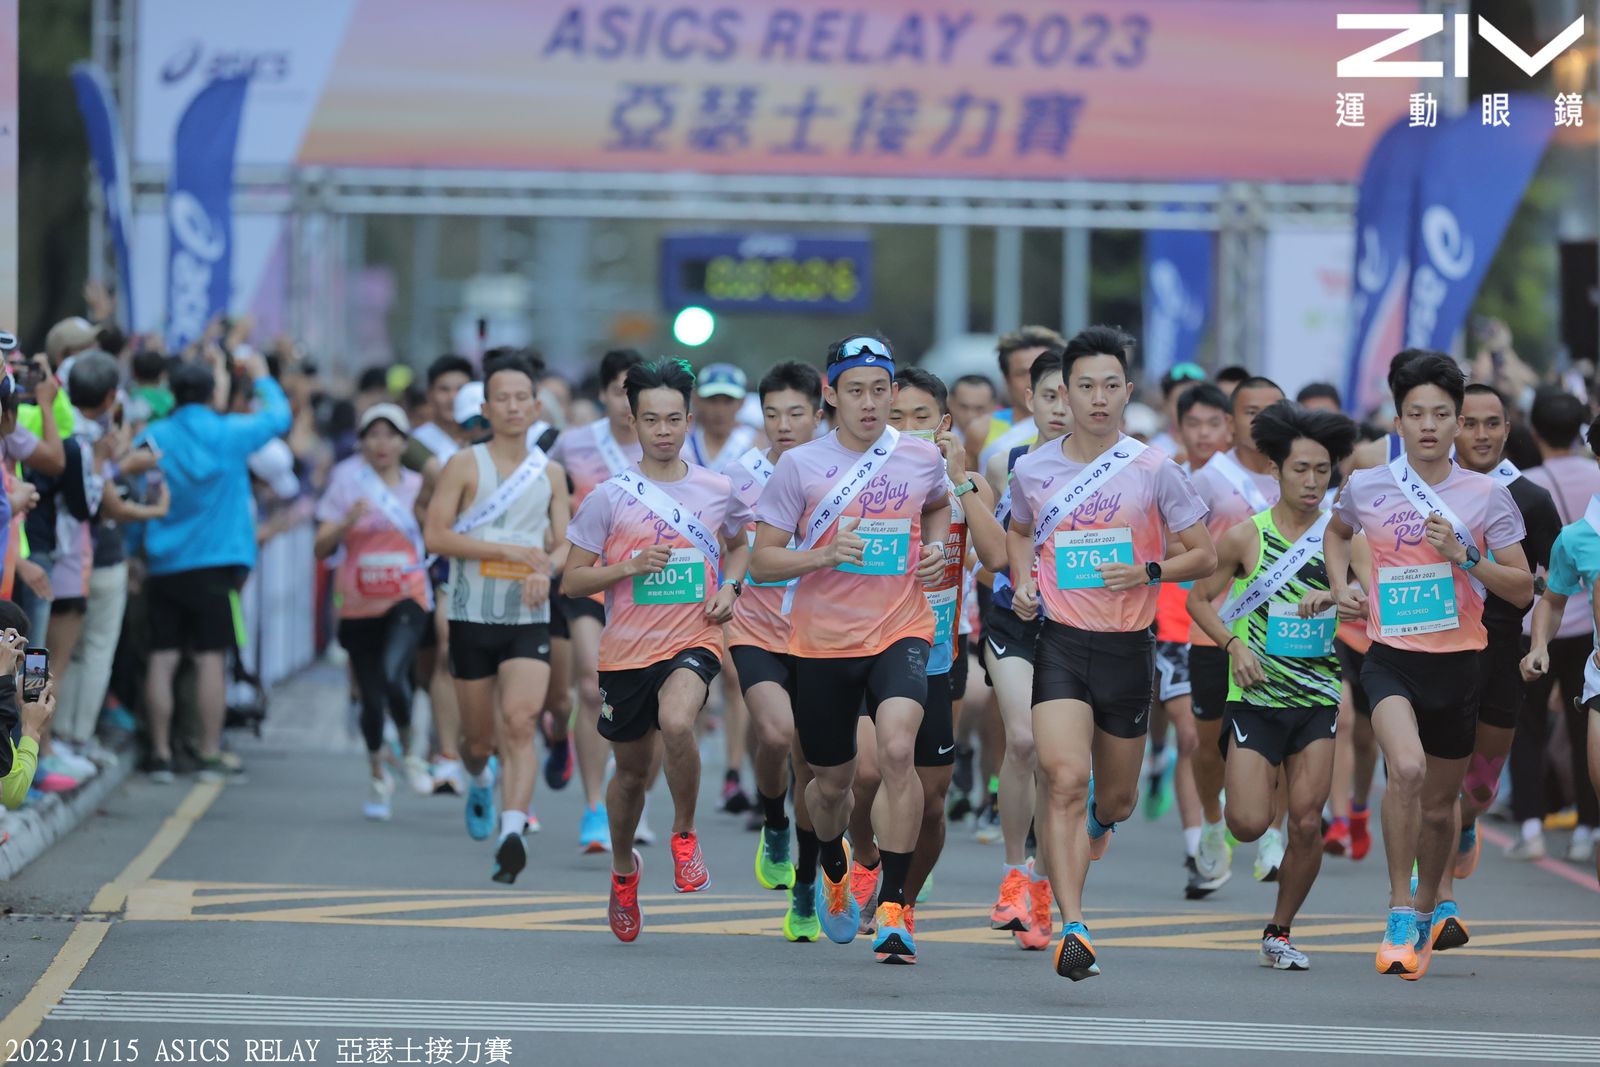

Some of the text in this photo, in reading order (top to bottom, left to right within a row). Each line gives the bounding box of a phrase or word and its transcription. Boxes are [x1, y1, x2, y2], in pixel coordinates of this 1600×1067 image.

[542, 5, 1153, 69] ASICS RELAY 2023
[601, 81, 1090, 158] 亞瑟士接力賽
[833, 461, 873, 506] ASICS
[859, 481, 909, 519] Relay
[1034, 461, 1111, 542] ASICS RELA
[1070, 492, 1122, 530] Relay
[1382, 509, 1424, 527] ASIC
[687, 523, 720, 560] ASICS
[861, 537, 898, 555] 75-1
[1066, 547, 1119, 569] 376-1
[643, 567, 693, 586] 200-1
[1264, 548, 1306, 588] ASICS
[1388, 583, 1440, 605] 377-1
[1278, 621, 1325, 639] 323-1
